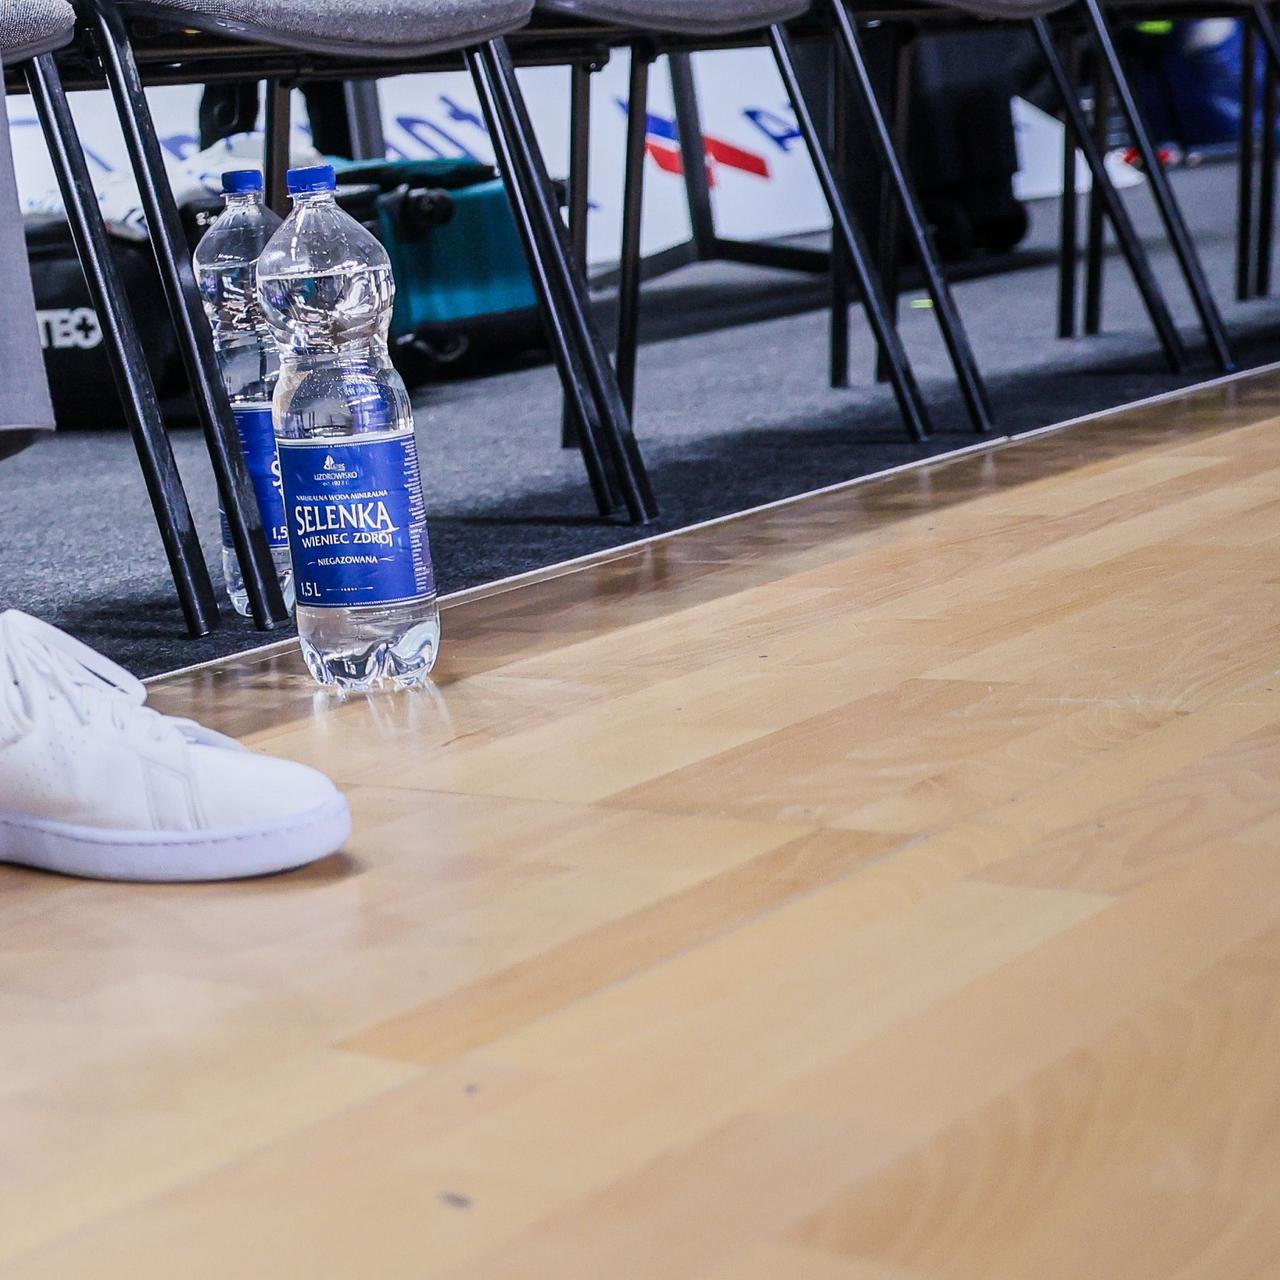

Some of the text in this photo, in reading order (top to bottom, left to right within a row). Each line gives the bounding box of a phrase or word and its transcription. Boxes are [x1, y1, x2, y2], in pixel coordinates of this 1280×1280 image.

[296, 489, 388, 502] NATURALNA WODA MINERALNA
[295, 501, 400, 535] SELENKA
[302, 532, 349, 548] WIENIEC
[317, 555, 378, 566] NIEGAZOWANA
